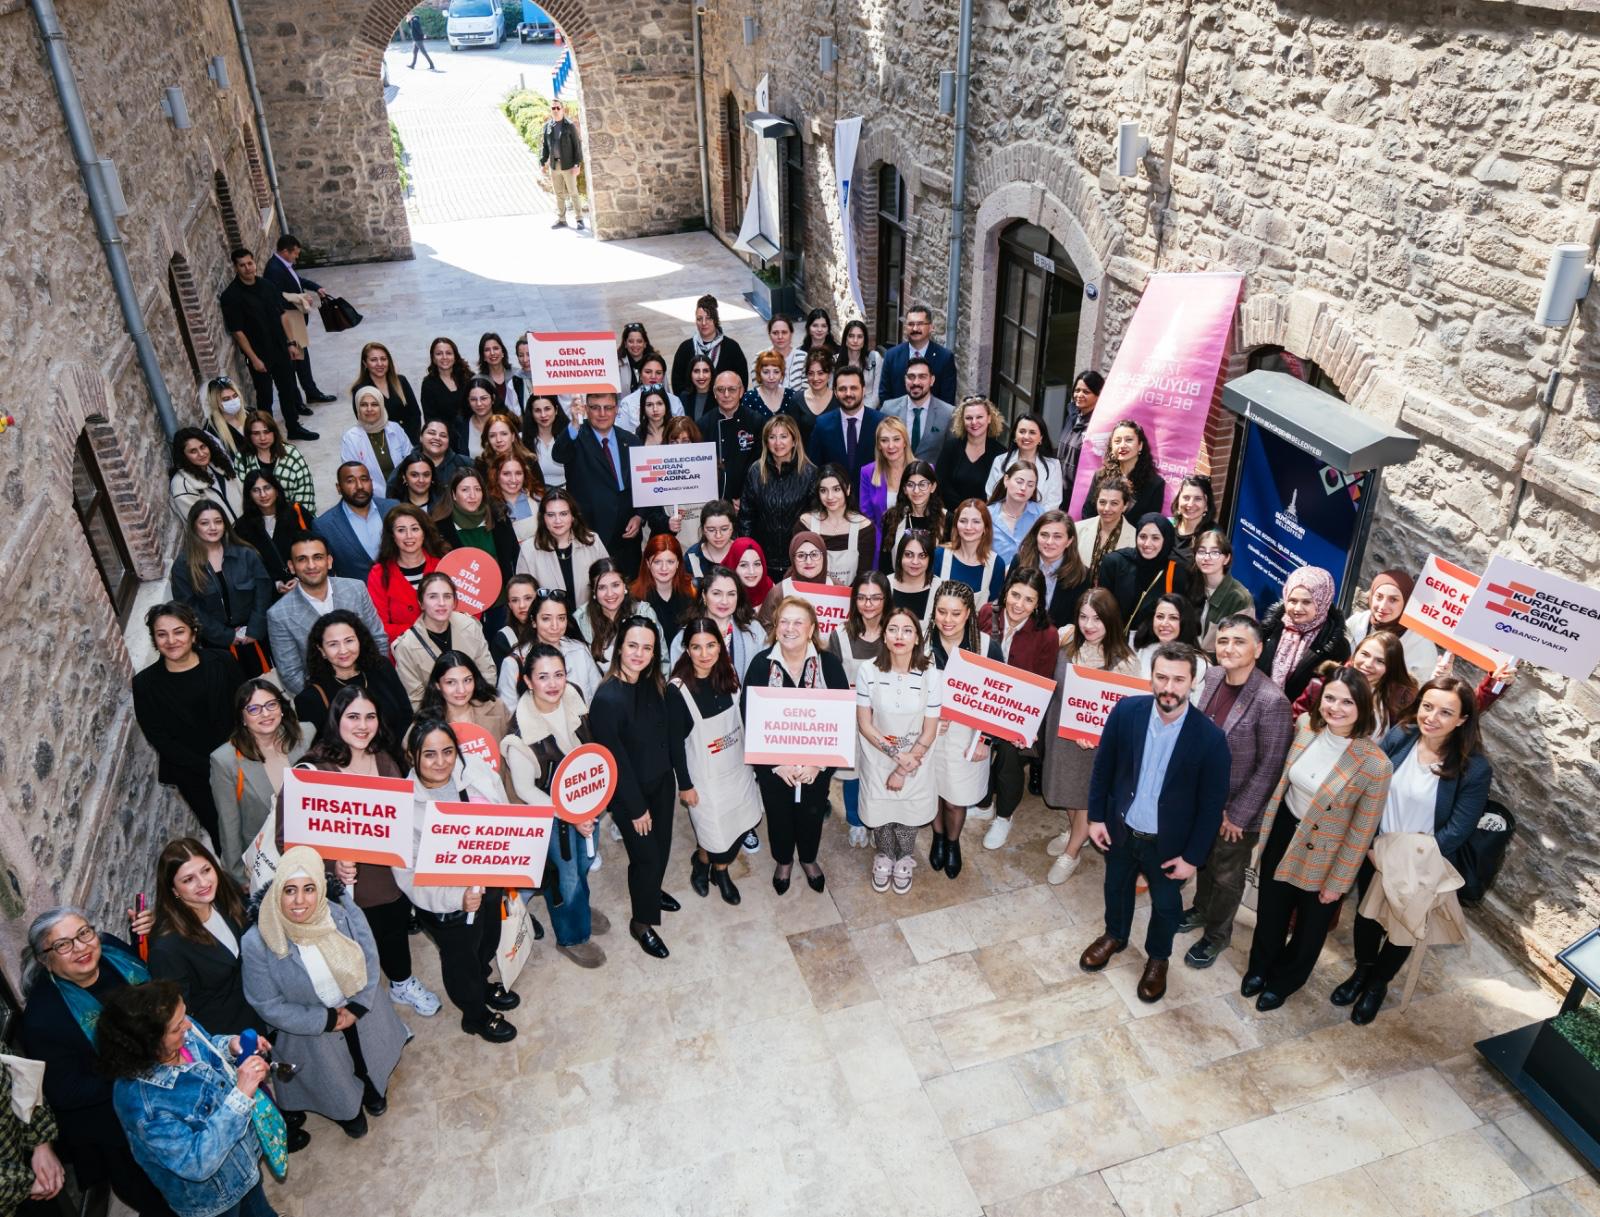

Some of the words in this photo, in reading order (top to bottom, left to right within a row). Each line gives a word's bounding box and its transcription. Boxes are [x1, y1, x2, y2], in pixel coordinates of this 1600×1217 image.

[558, 348, 586, 357] GENÇ
[545, 358, 604, 367] KADINLARIN
[546, 369, 606, 378] YANINDAYIZ!
[664, 455, 712, 464] GELECEĞİNİ
[470, 560, 480, 572] İŞ
[459, 569, 480, 584] STAJ
[1426, 576, 1457, 598] GENÇ
[1421, 604, 1440, 620] BİZ
[1513, 592, 1562, 616] KURAN
[1512, 610, 1580, 641] KADINLAR
[1530, 608, 1568, 628] GENÇ
[1541, 640, 1568, 652] VAKFI
[984, 677, 1013, 694] NEET
[947, 678, 979, 700] GENÇ
[982, 690, 1040, 718] KADINLAR
[1068, 696, 1098, 712] GENÇ
[783, 707, 816, 720] GENÇ
[952, 692, 1025, 726] GÜÇLENİYOR
[764, 720, 838, 732] KADINLARIN
[1076, 712, 1104, 728] GÜÇL
[764, 734, 838, 746] YANINDAYIZ!
[564, 771, 588, 789] BEN
[590, 764, 604, 778] DE
[566, 778, 606, 803] VARIM!
[302, 796, 397, 819] FIRSATLAR
[308, 817, 390, 838] HARİTASI
[432, 824, 470, 838] GENÇ
[476, 825, 544, 838] KADINLAR
[458, 840, 510, 851] NEREDE
[434, 851, 458, 864] BİZ
[462, 854, 531, 866] ORADAYIZ
